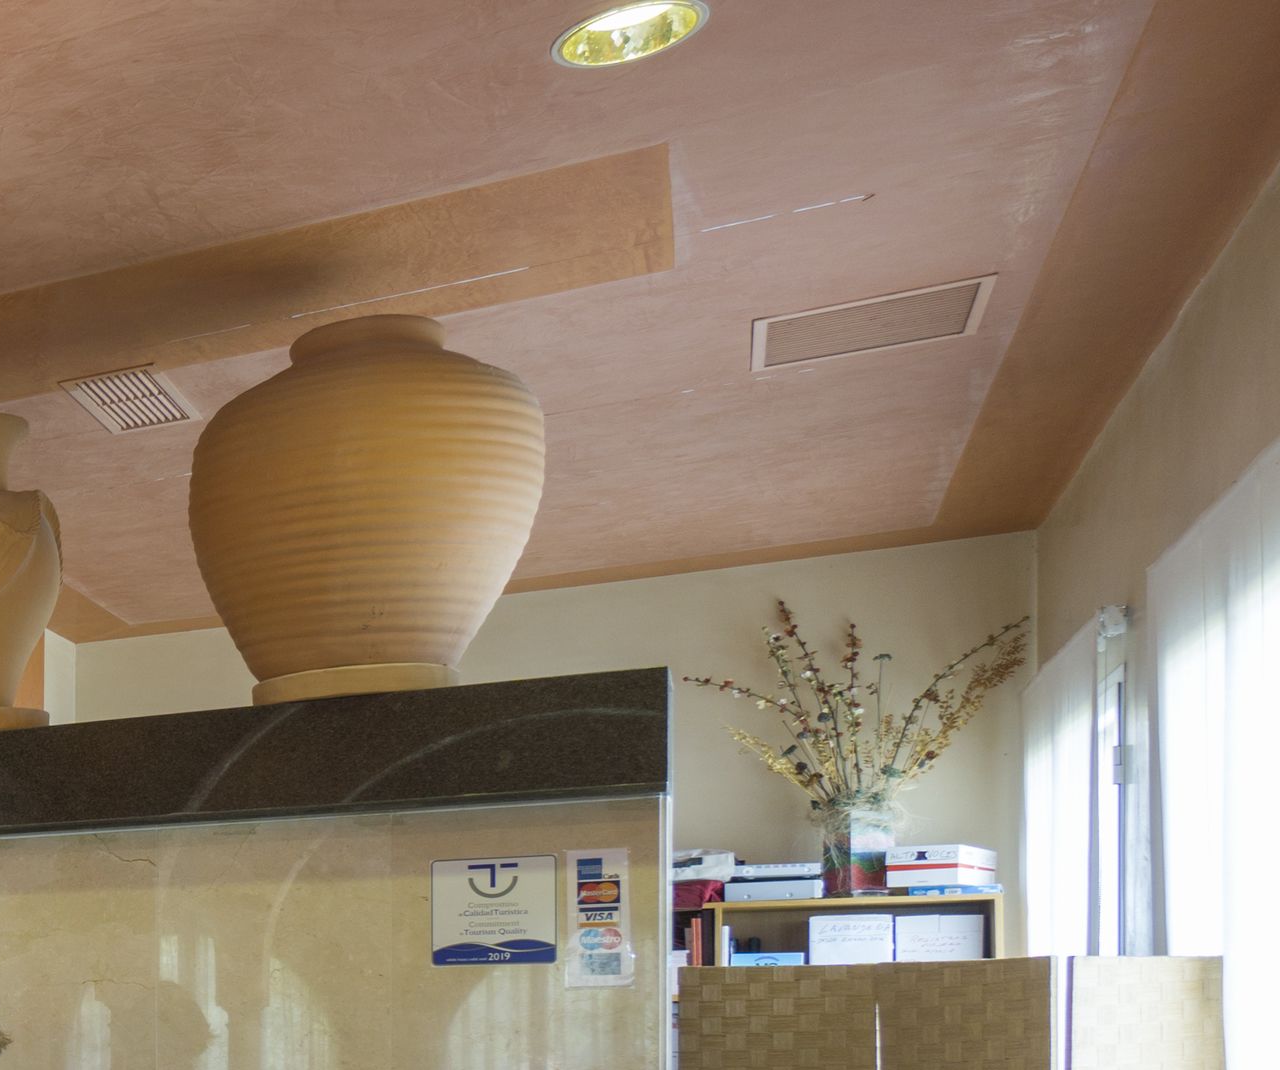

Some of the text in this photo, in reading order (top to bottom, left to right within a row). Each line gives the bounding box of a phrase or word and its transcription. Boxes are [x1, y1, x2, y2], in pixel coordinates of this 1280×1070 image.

[584, 912, 614, 921] VISA
[497, 927, 528, 936] Quality
[581, 935, 622, 944] Maestro
[487, 952, 511, 961] 2019
